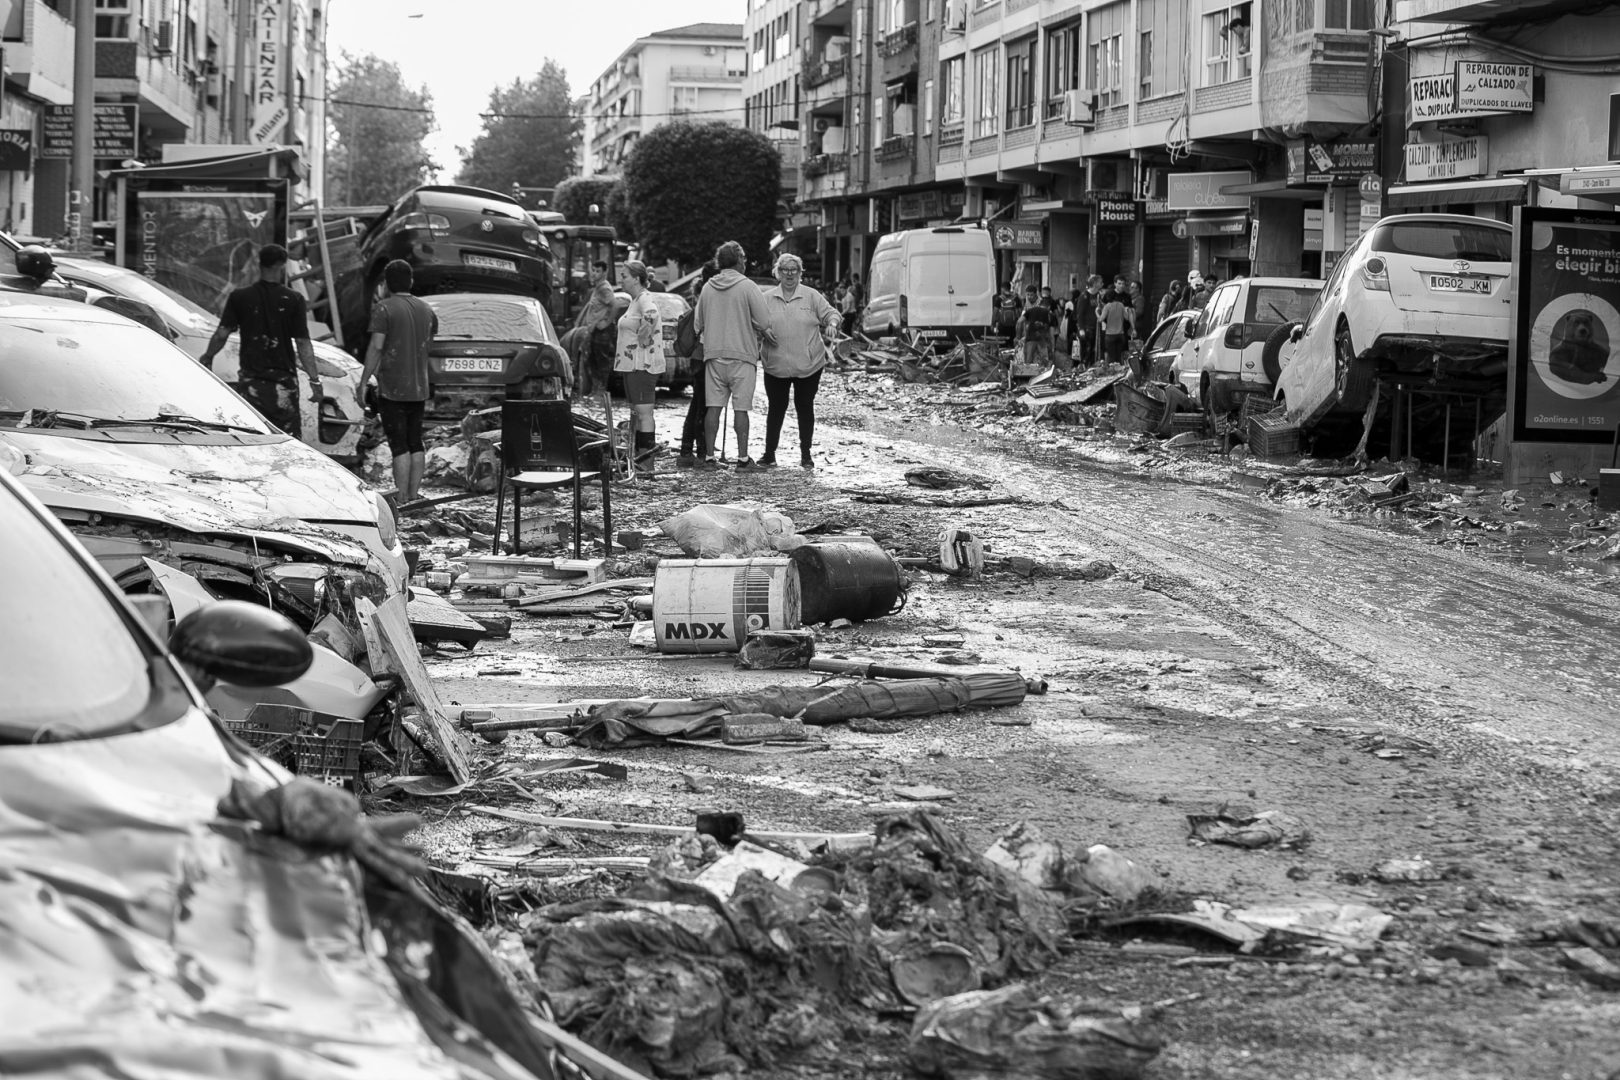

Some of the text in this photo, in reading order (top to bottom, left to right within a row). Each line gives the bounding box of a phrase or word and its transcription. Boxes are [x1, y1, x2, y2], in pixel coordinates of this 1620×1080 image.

[259, 5, 277, 104] ATIENZAR
[1466, 63, 1529, 77] REPARACION DE
[1478, 78, 1515, 90] CALZADO
[1461, 98, 1499, 107] DUPLICADOS
[1510, 101, 1532, 109] LLAVES
[255, 108, 285, 142] Allianz
[0, 131, 30, 151] ORIA
[1333, 143, 1374, 155] MOBILE
[1408, 145, 1431, 166] CALZADO
[1436, 139, 1477, 164] COMPLEMENTOS
[1338, 156, 1374, 167] STORE
[1361, 176, 1380, 191] ria
[1100, 201, 1135, 210] Phone
[1100, 211, 1135, 220] House
[1556, 245, 1570, 254] Es
[1555, 256, 1601, 275] elegir
[1437, 277, 1489, 291] 0502 JKM
[447, 360, 500, 370] 7698 CNZ
[1534, 414, 1604, 424] o2online.es 1551
[665, 622, 729, 640] MDX
